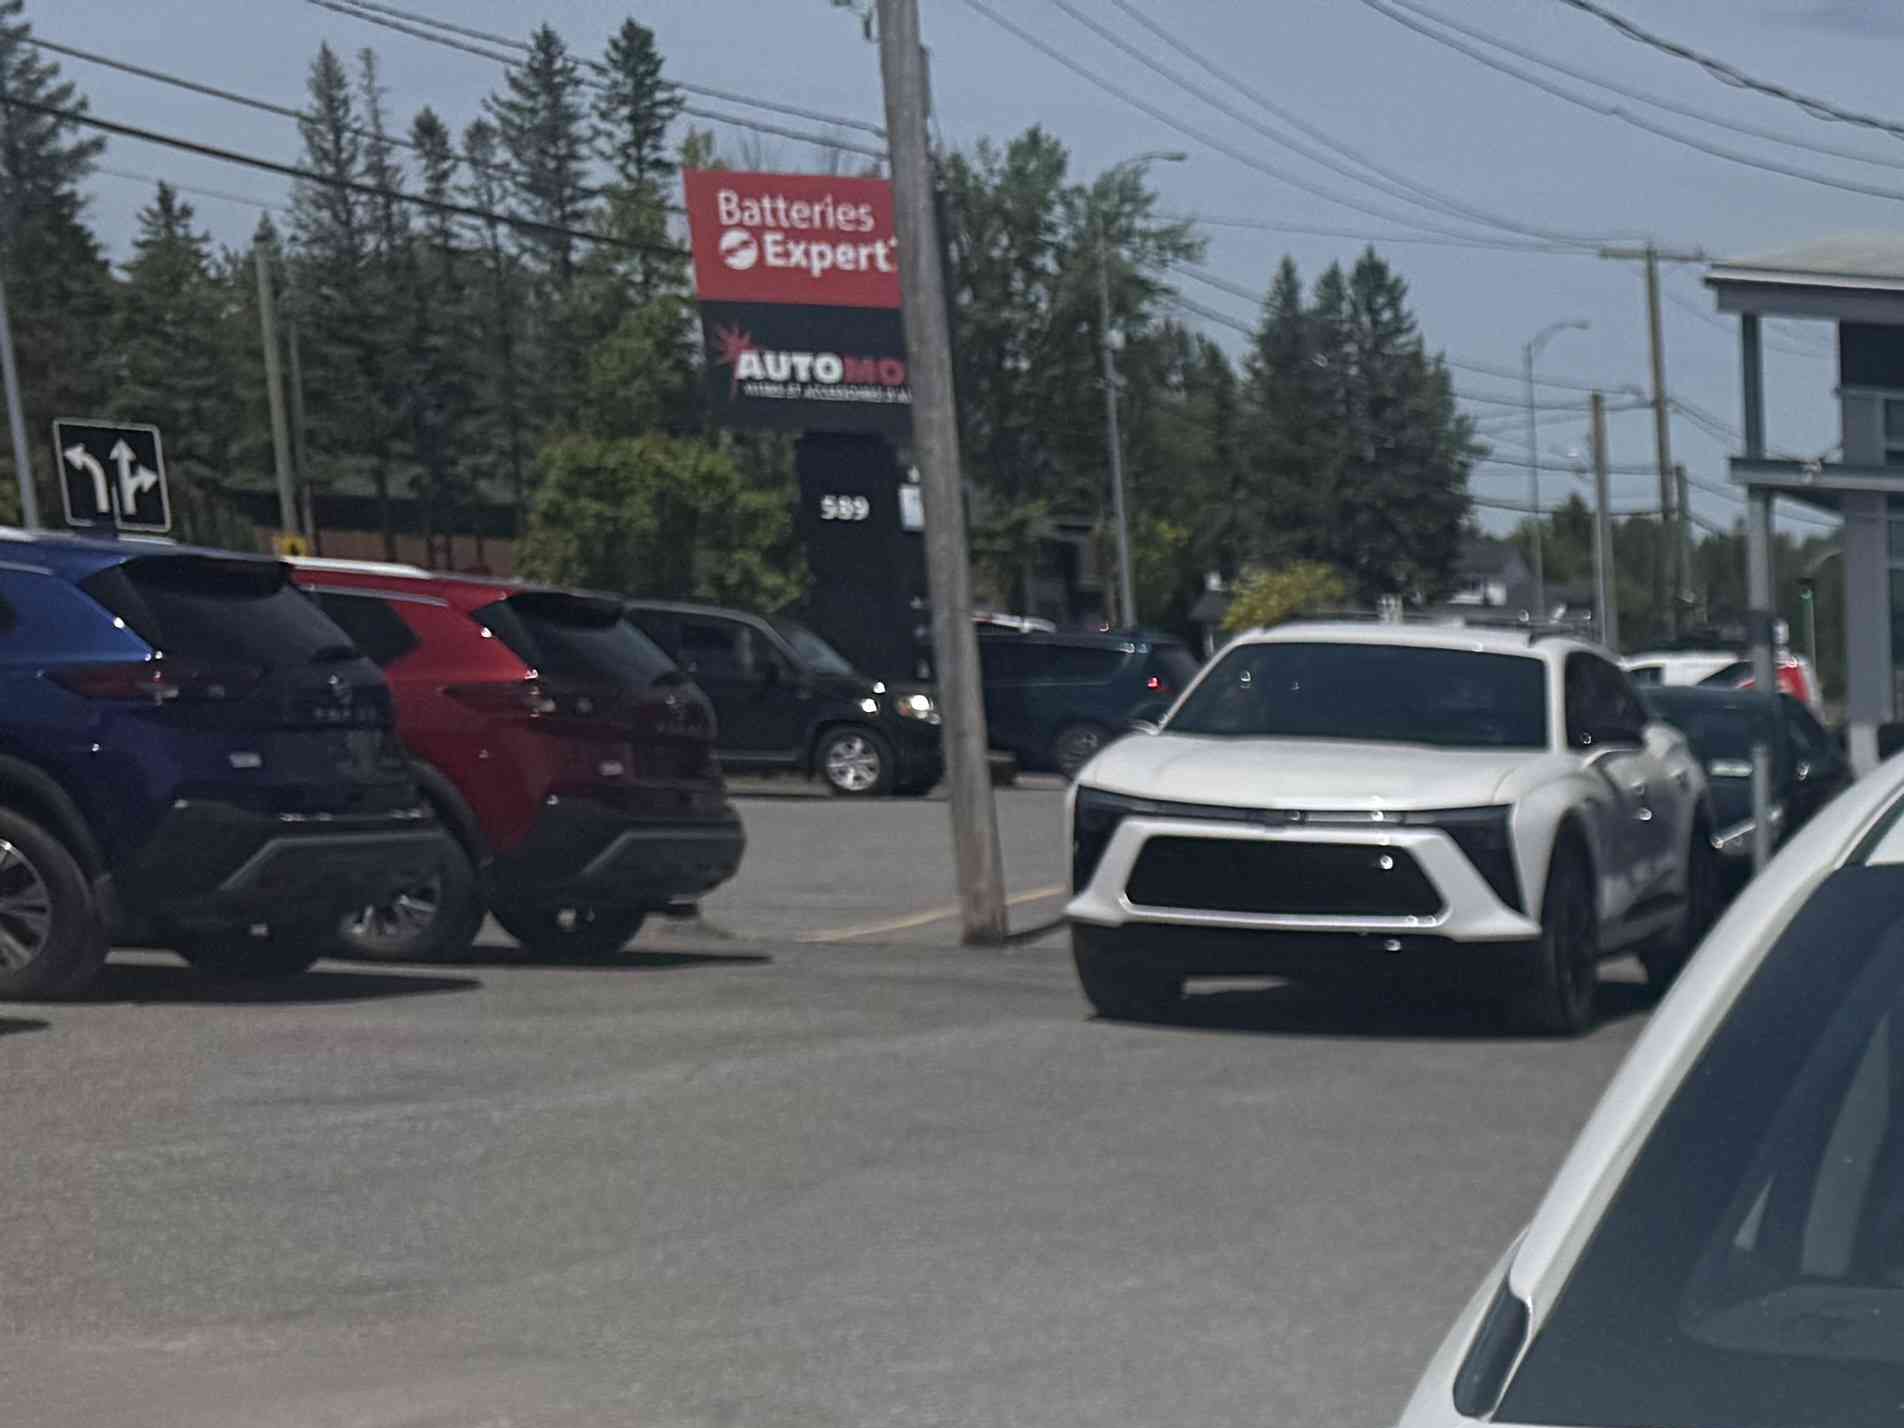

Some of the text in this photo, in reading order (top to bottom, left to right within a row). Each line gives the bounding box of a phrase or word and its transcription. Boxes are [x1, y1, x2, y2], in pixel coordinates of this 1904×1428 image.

[717, 188, 875, 232] Batteries
[762, 229, 894, 278] Expert
[734, 349, 905, 386] AUTOMO
[821, 494, 870, 520] 589
